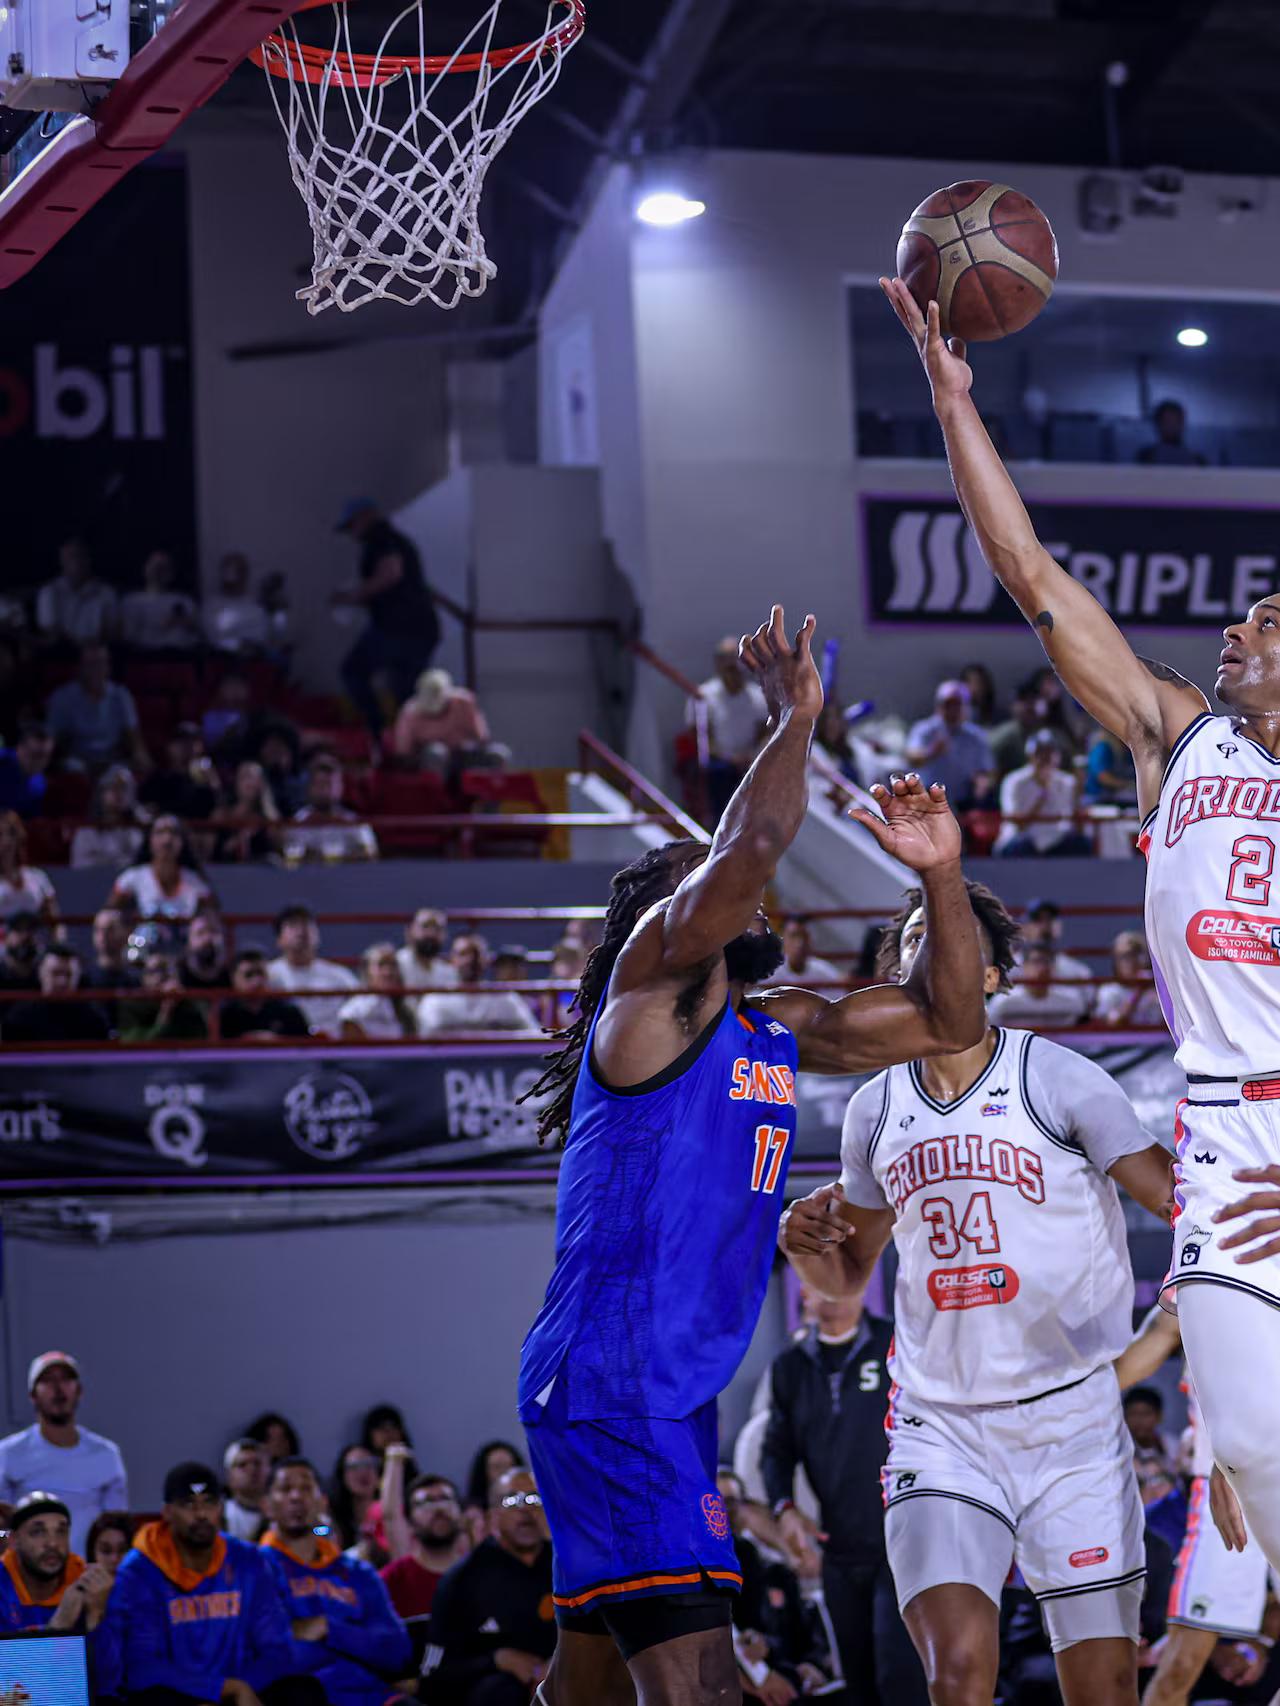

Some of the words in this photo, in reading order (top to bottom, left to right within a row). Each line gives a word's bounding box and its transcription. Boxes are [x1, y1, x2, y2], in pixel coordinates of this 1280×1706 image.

[1226, 834, 1275, 906] 2
[1198, 916, 1272, 942] CALESA
[1230, 939, 1264, 949] TOYOTA
[151, 1104, 209, 1168] Q
[751, 1125, 790, 1194] 17
[881, 1134, 1046, 1213] CRIOLLOS
[920, 1191, 1001, 1260] 34
[860, 1360, 880, 1391] S
